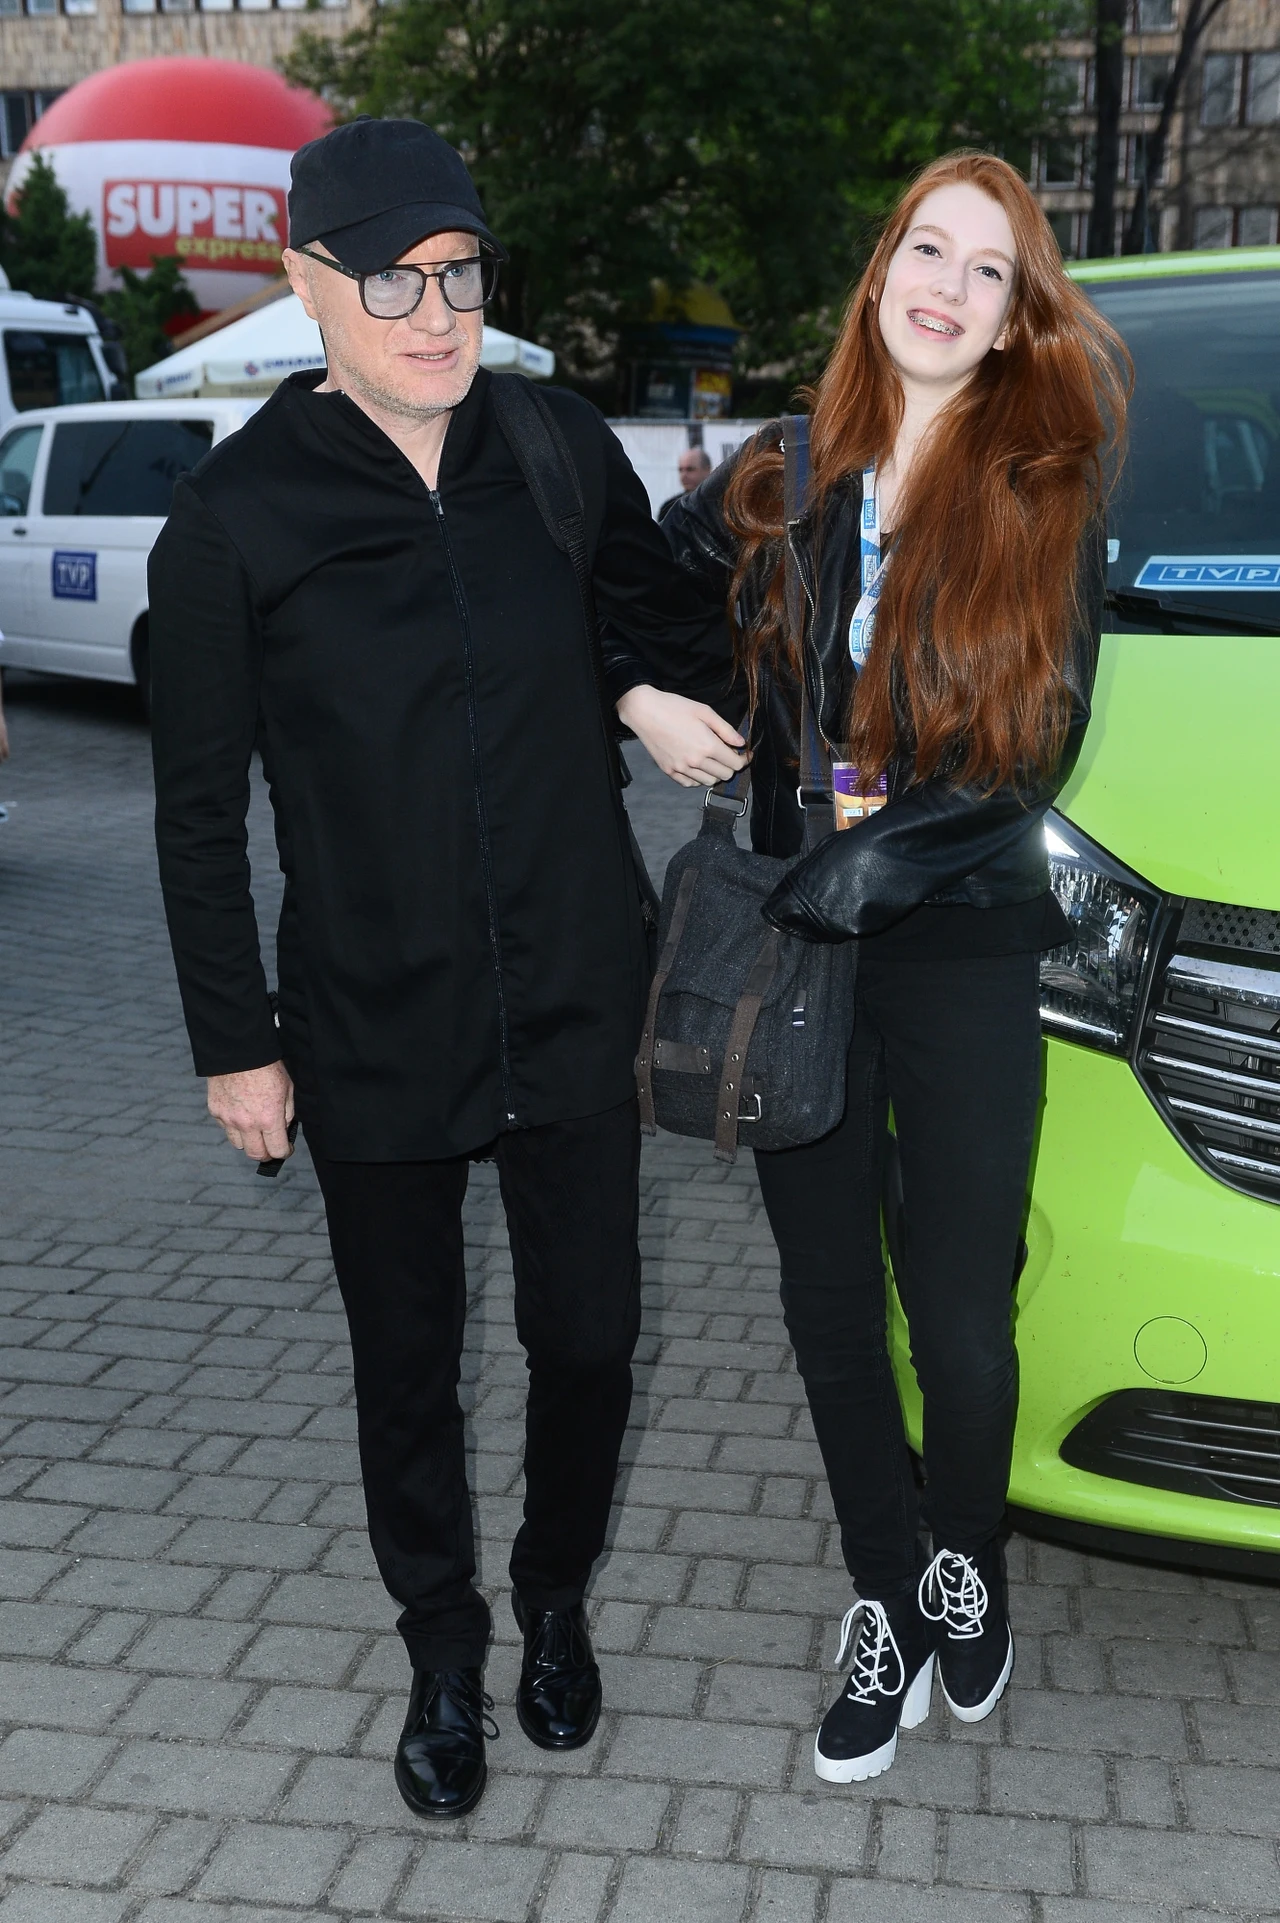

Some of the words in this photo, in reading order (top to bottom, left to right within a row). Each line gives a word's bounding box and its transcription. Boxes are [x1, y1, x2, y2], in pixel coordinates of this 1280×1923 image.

[106, 183, 281, 241] SUPER
[174, 237, 282, 262] express
[58, 562, 90, 588] TVP
[1171, 568, 1271, 580] TVP
